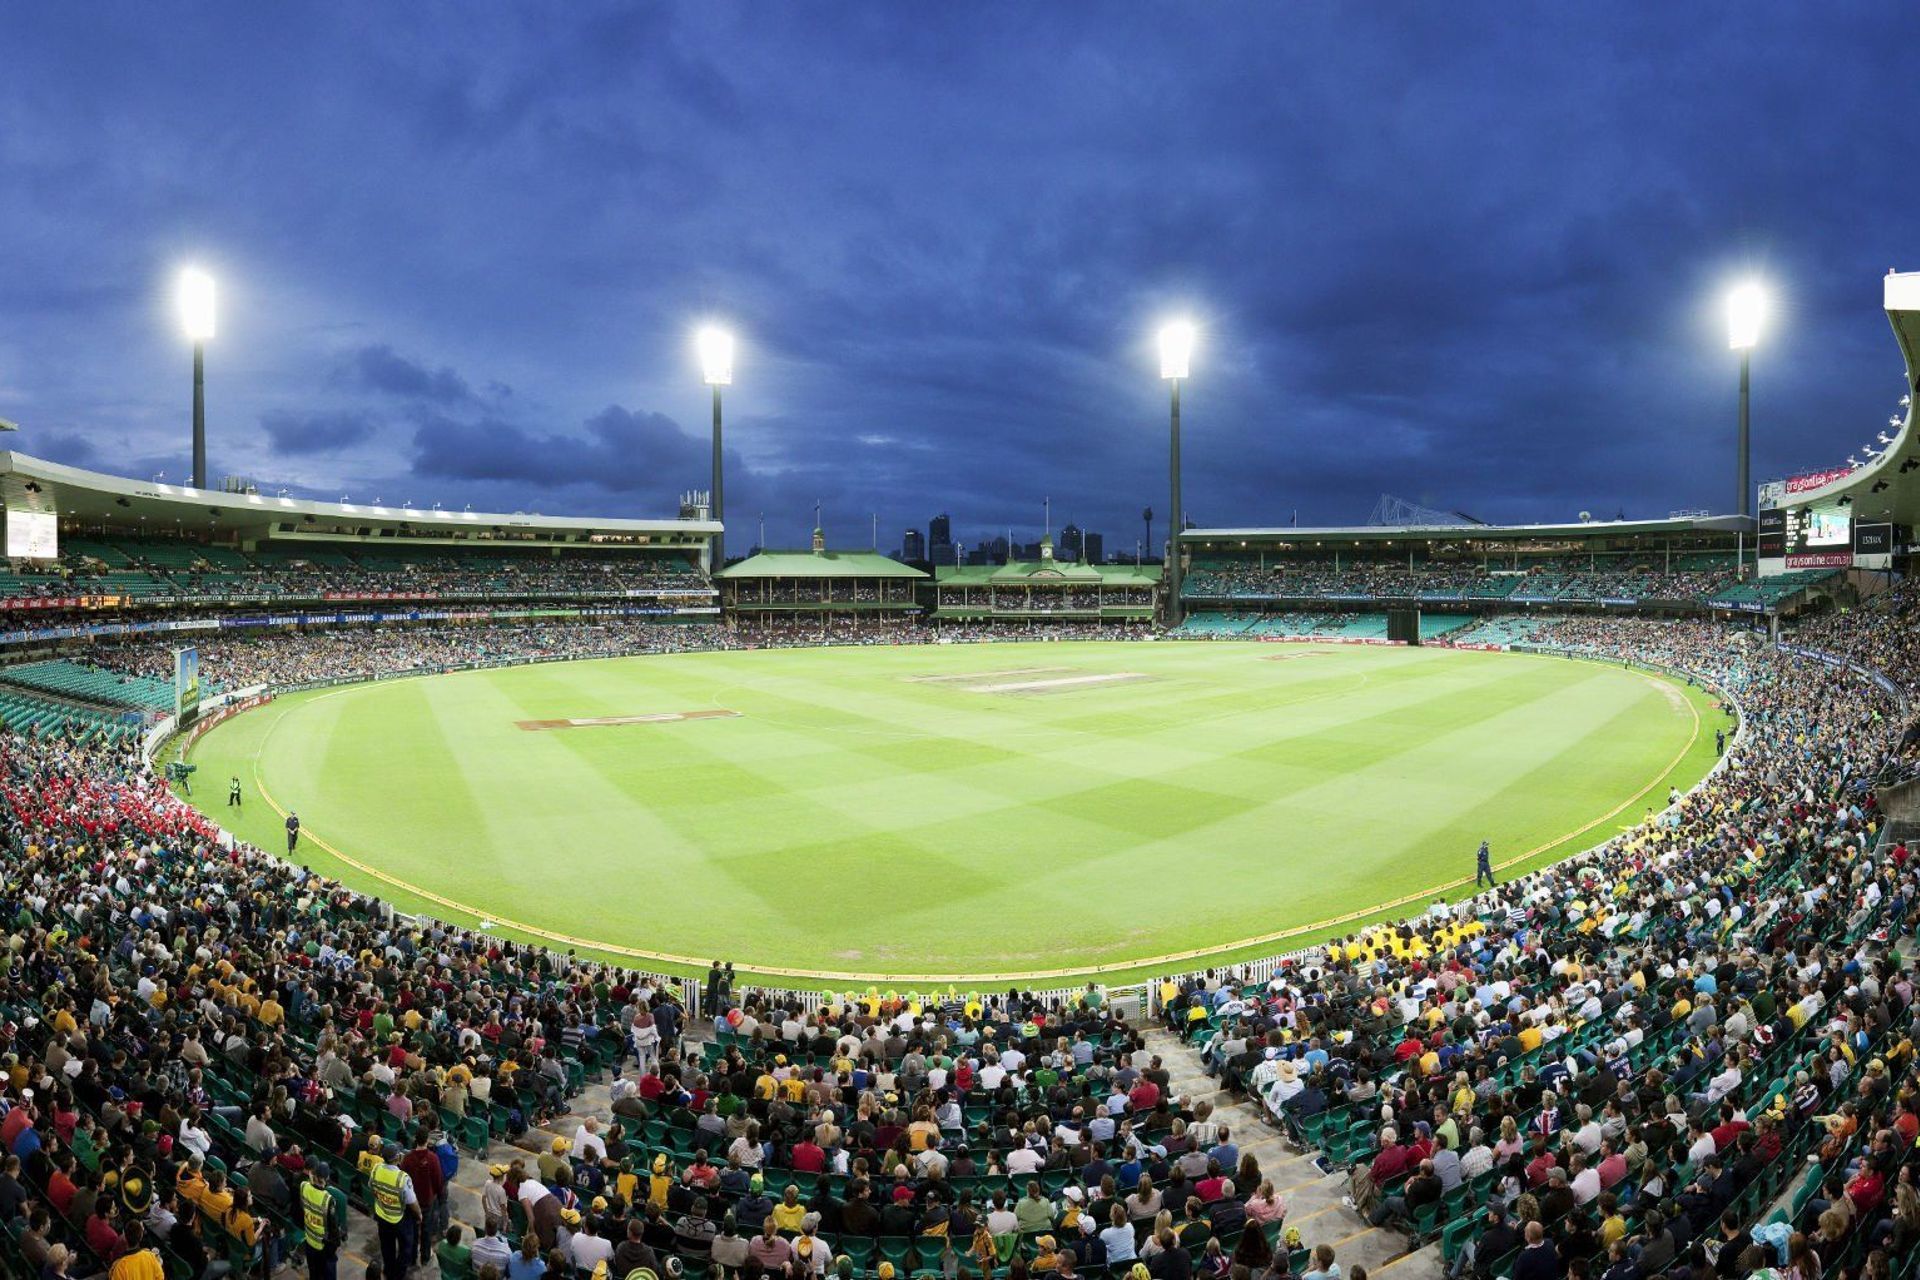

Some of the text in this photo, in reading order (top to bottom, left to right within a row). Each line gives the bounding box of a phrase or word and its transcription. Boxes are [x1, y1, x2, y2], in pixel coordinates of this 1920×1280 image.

[1786, 556, 1852, 568] graysonline.com.au
[307, 616, 337, 624] SAMSUNG
[345, 614, 374, 622] SAMSUNG
